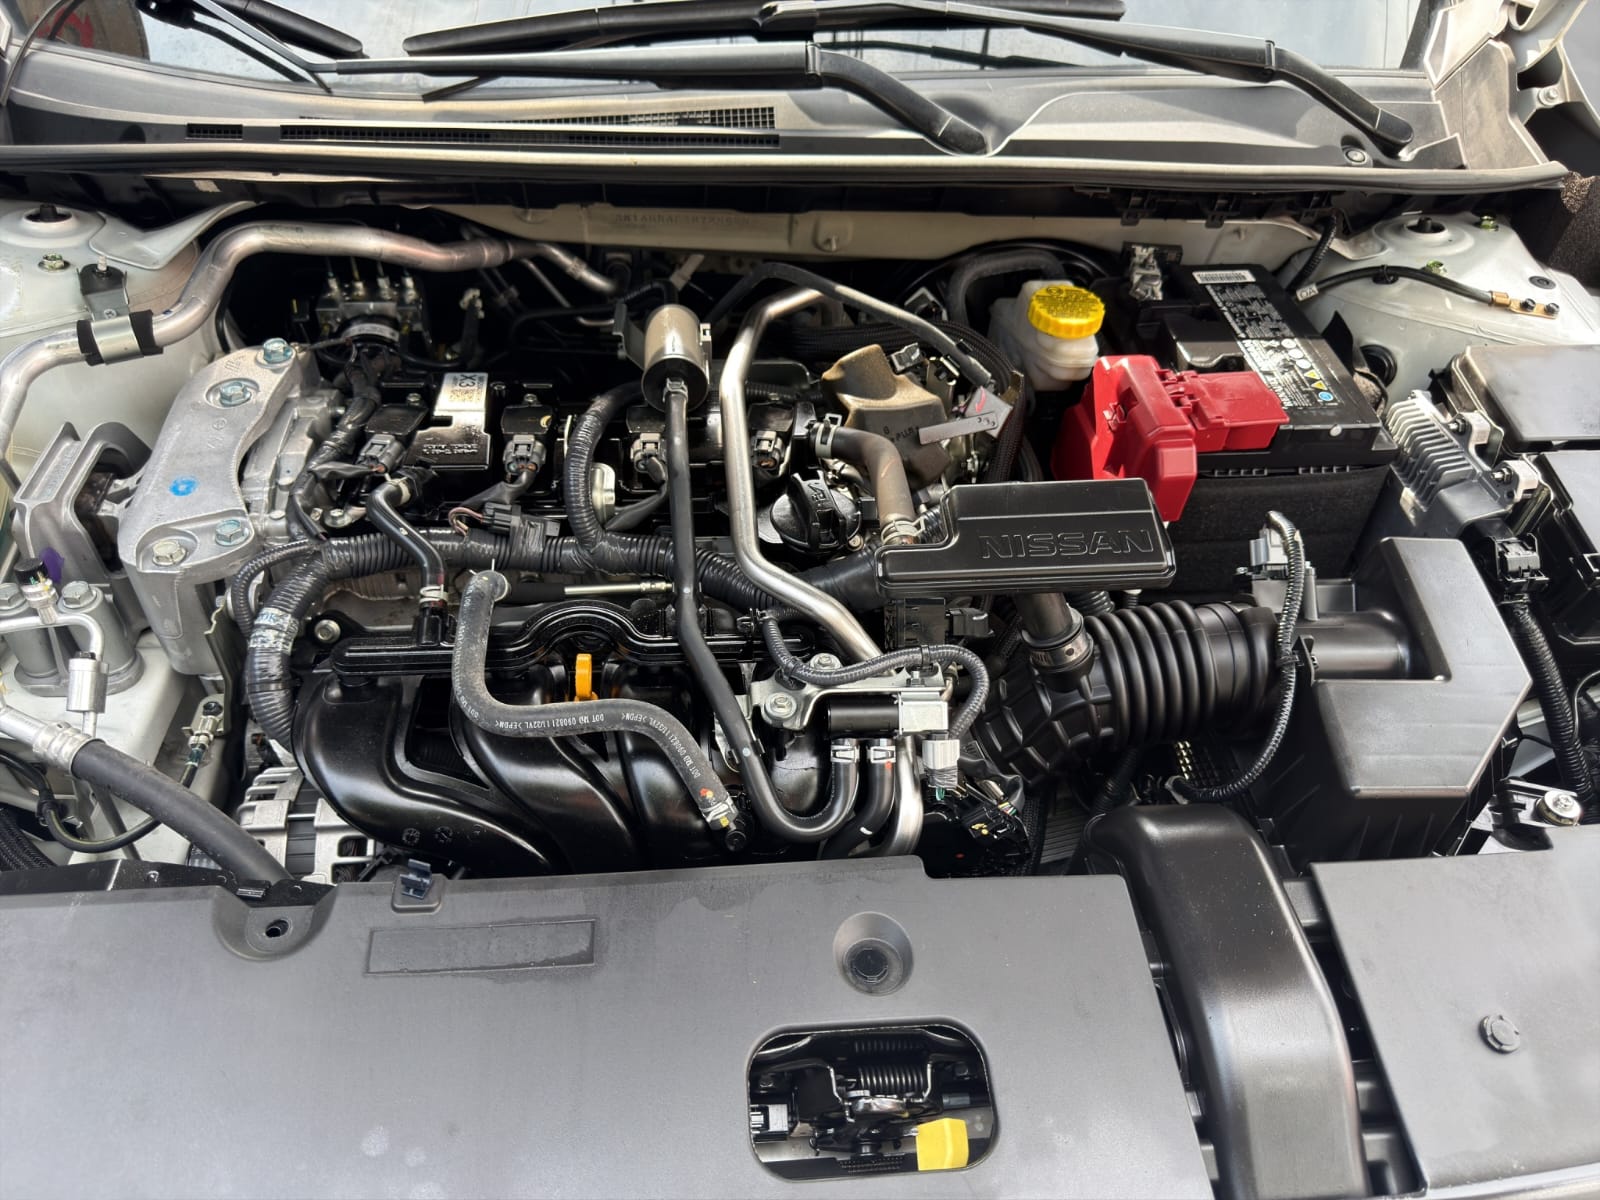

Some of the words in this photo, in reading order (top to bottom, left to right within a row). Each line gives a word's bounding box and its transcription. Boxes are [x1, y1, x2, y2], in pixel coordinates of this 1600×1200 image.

[459, 374, 477, 388] X3
[979, 529, 1154, 559] NISSAN
[592, 713, 605, 723] DOT
